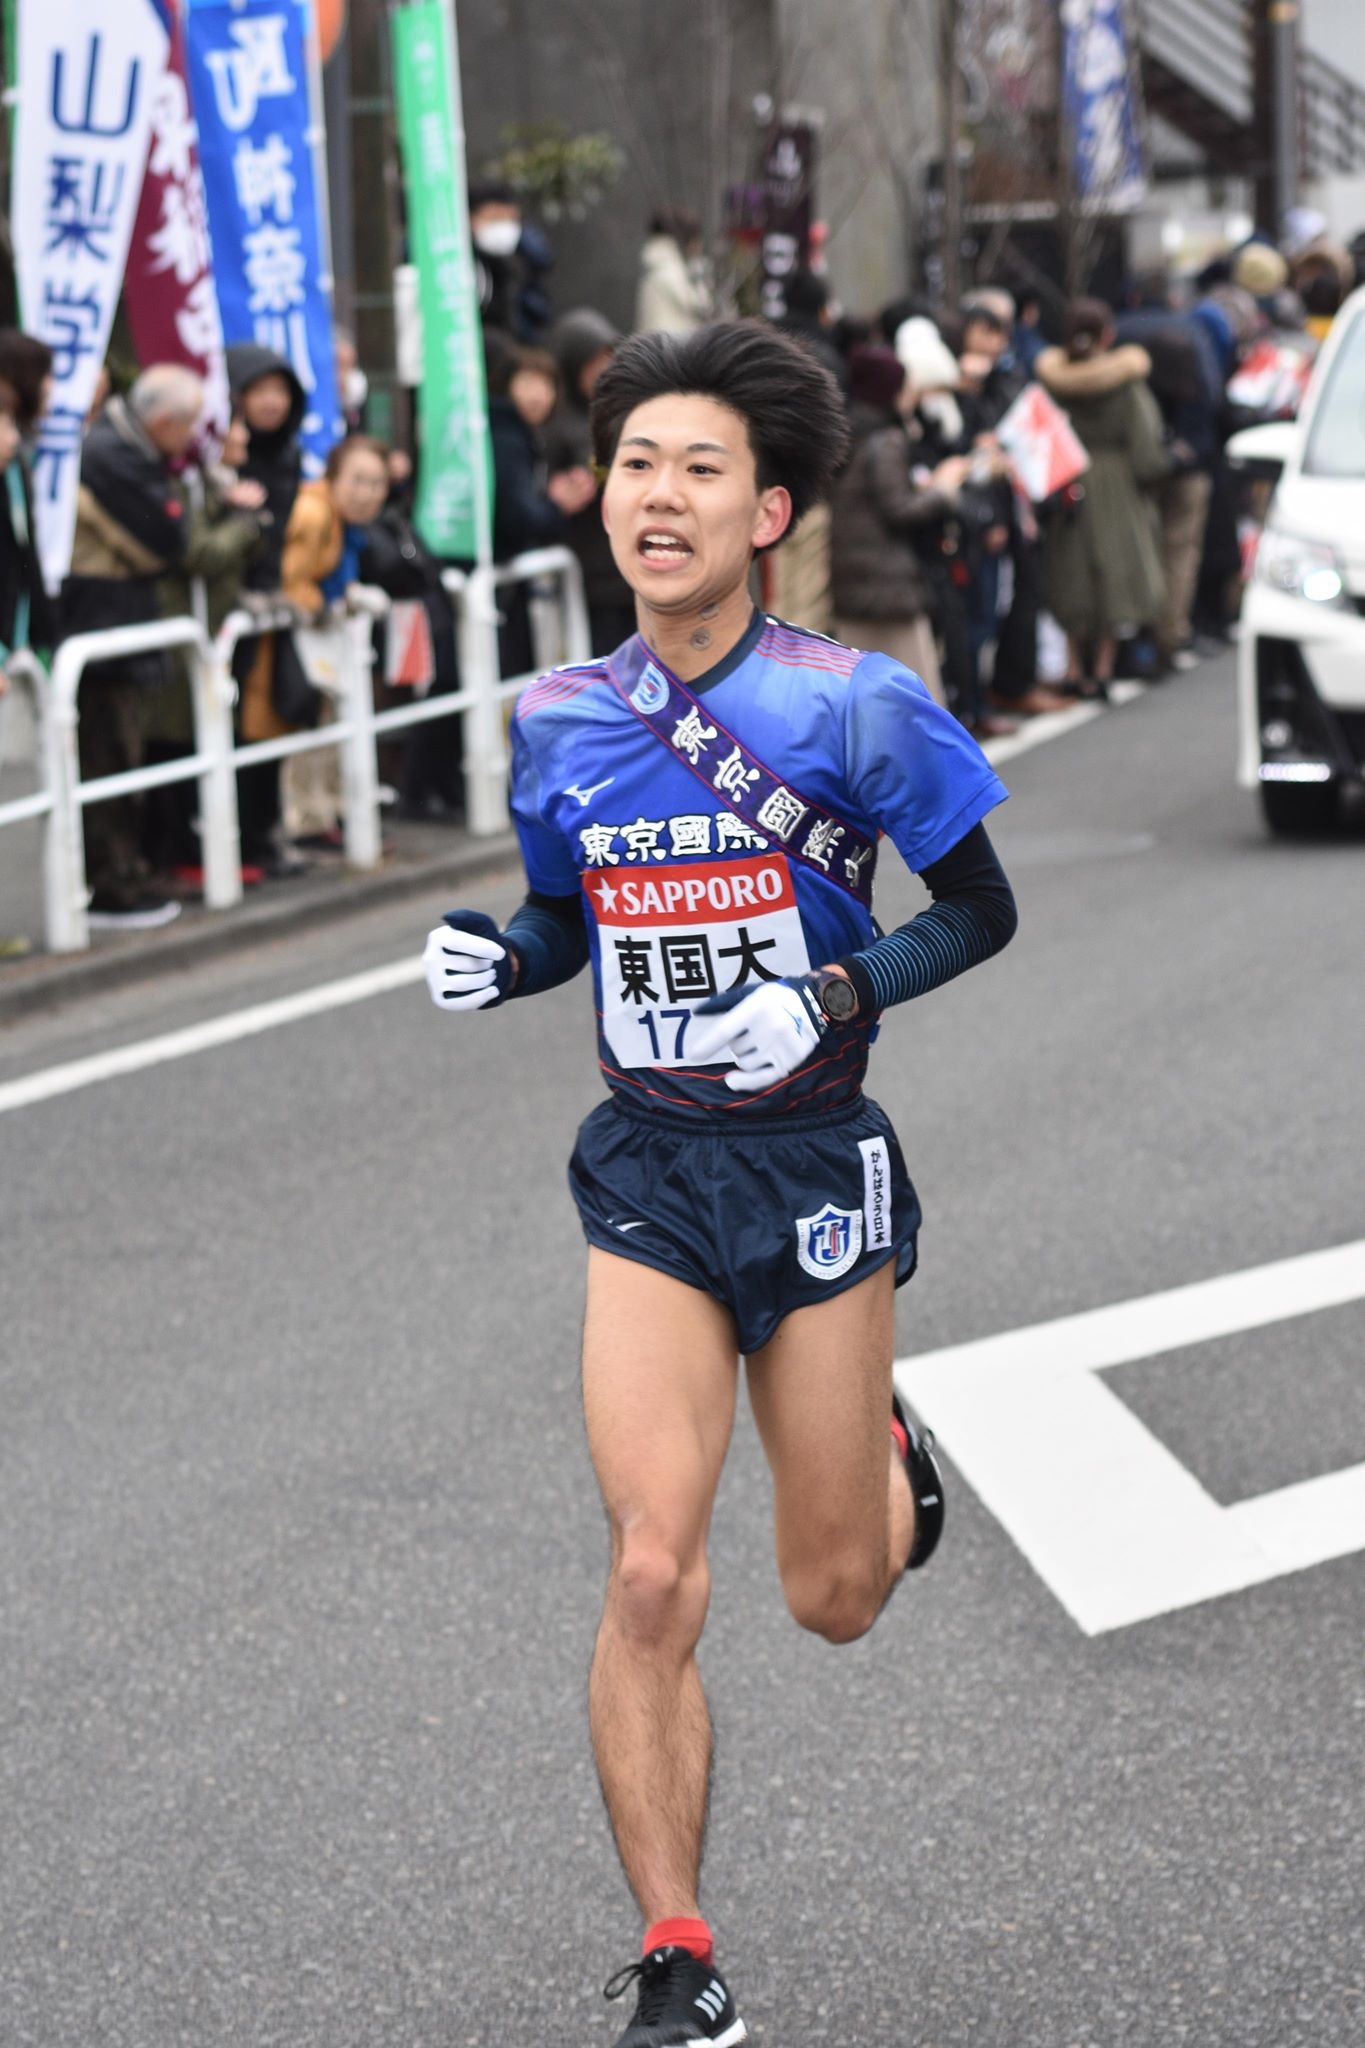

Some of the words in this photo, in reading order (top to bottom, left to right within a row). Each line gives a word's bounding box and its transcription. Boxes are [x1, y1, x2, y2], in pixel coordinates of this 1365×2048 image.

[622, 868, 784, 915] SAPPORO
[614, 927, 783, 1004] 東国大
[870, 1149, 885, 1244] がんばろう日本
